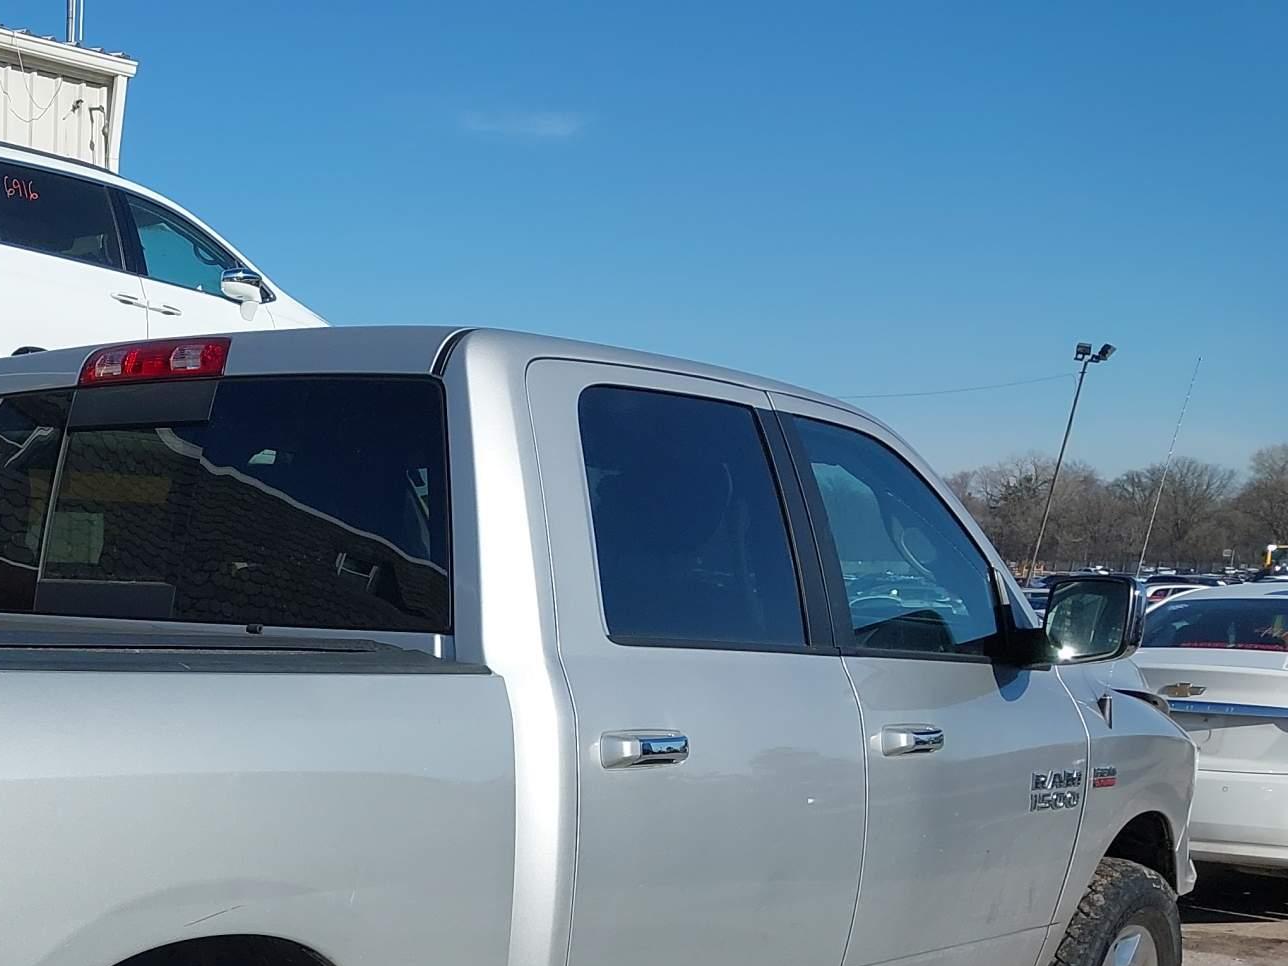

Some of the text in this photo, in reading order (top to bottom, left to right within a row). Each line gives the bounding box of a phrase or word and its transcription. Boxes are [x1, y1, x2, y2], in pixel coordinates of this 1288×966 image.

[3, 175, 39, 200] 6916
[1031, 769, 1082, 790] RAM
[1029, 790, 1080, 812] 1500
